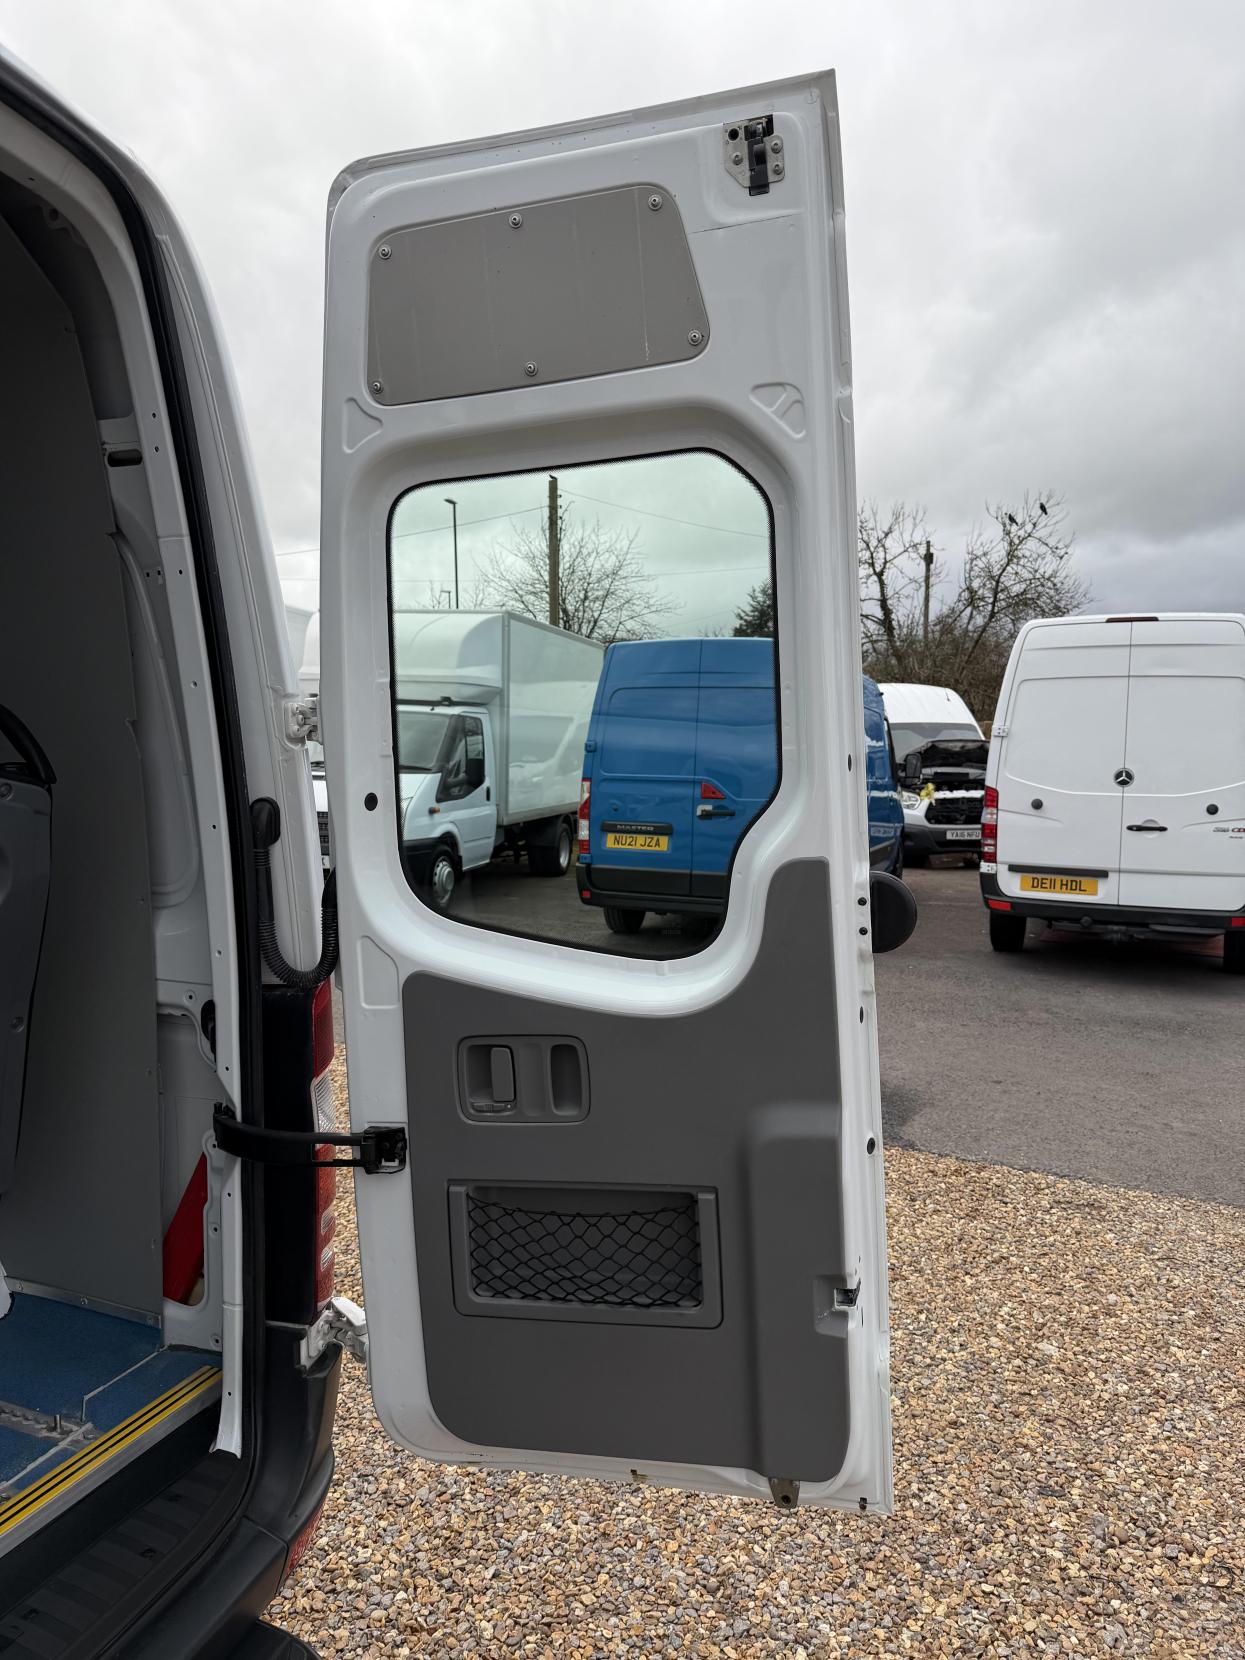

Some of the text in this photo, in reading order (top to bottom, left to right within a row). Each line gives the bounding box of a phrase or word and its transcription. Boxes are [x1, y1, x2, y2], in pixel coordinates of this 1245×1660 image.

[613, 834, 661, 848] NU21 JZA
[1031, 877, 1088, 892] DE11 HDL
